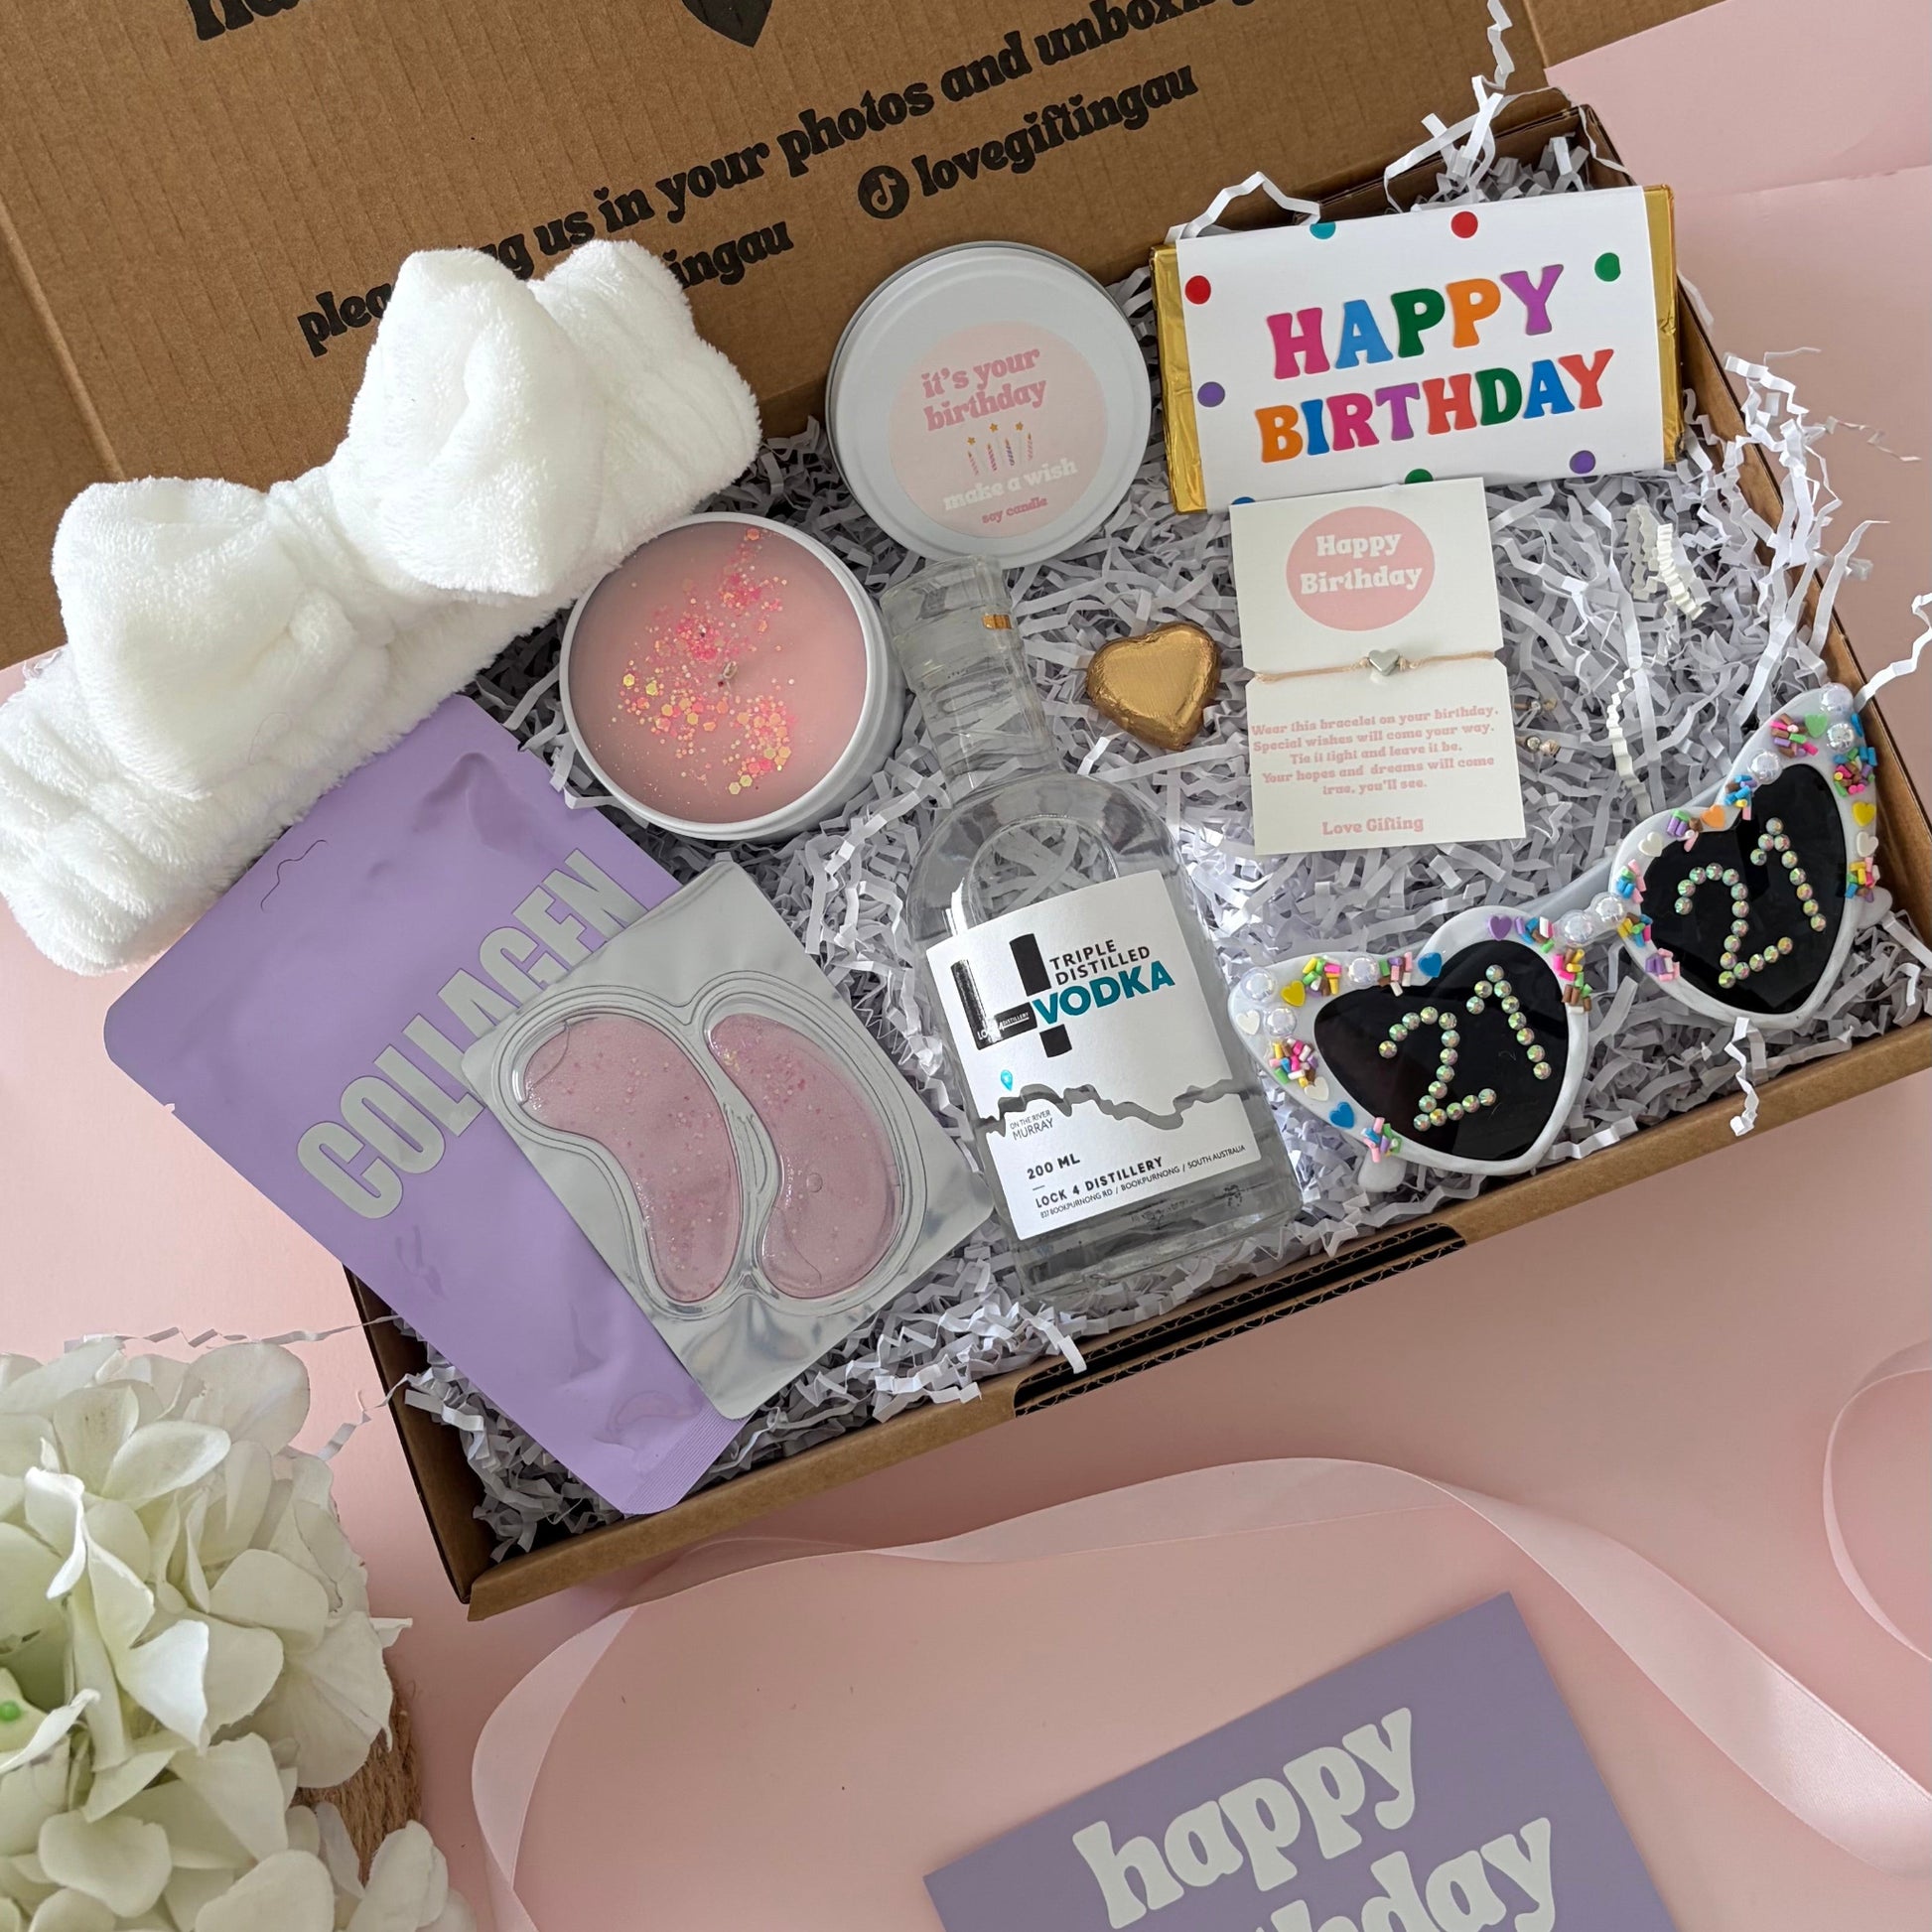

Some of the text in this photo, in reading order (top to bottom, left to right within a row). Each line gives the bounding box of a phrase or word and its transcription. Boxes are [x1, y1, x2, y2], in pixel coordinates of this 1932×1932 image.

[911, 65, 1199, 198] lovegiftingau
[298, 0, 1256, 358] plea us in your photos and unbox
[1267, 264, 1564, 380] HAPPY
[921, 348, 1040, 398] it's your
[923, 379, 1046, 431] birthday
[1255, 348, 1614, 464] BIRTHDAY
[943, 458, 1078, 511] make a wish
[982, 496, 1048, 524] soy candle
[1315, 532, 1403, 559] Happy
[1299, 564, 1423, 596] Birthday
[1251, 705, 1499, 736] Wear this bracelet on your birthday.
[1253, 723, 1495, 755] Special wishes will come your way.
[1262, 757, 1494, 784] Your hopes and dreams will come
[1291, 741, 1463, 765] Tie it tight and leave it be.
[1400, 779, 1428, 790] see.
[1321, 816, 1424, 836] Love Gifting
[1676, 816, 1829, 989] 21
[1049, 939, 1117, 971] TRIPLE
[1054, 946, 1151, 986] DISTILLED
[1032, 960, 1175, 1025] VODKA
[1379, 964, 1553, 1133] 21
[1012, 1118, 1054, 1141] MURRAY
[1020, 1115, 1033, 1127] THE
[1032, 1109, 1052, 1124] RIVER
[1027, 1153, 1080, 1179] 200 ML
[1035, 1157, 1163, 1208] LOCK 4 DISTILLERY
[1102, 1188, 1113, 1198] RD
[1187, 1155, 1212, 1170] SOUTH
[1212, 1145, 1246, 1162] AUSTRALIA
[1072, 1708, 1415, 1929] happy
